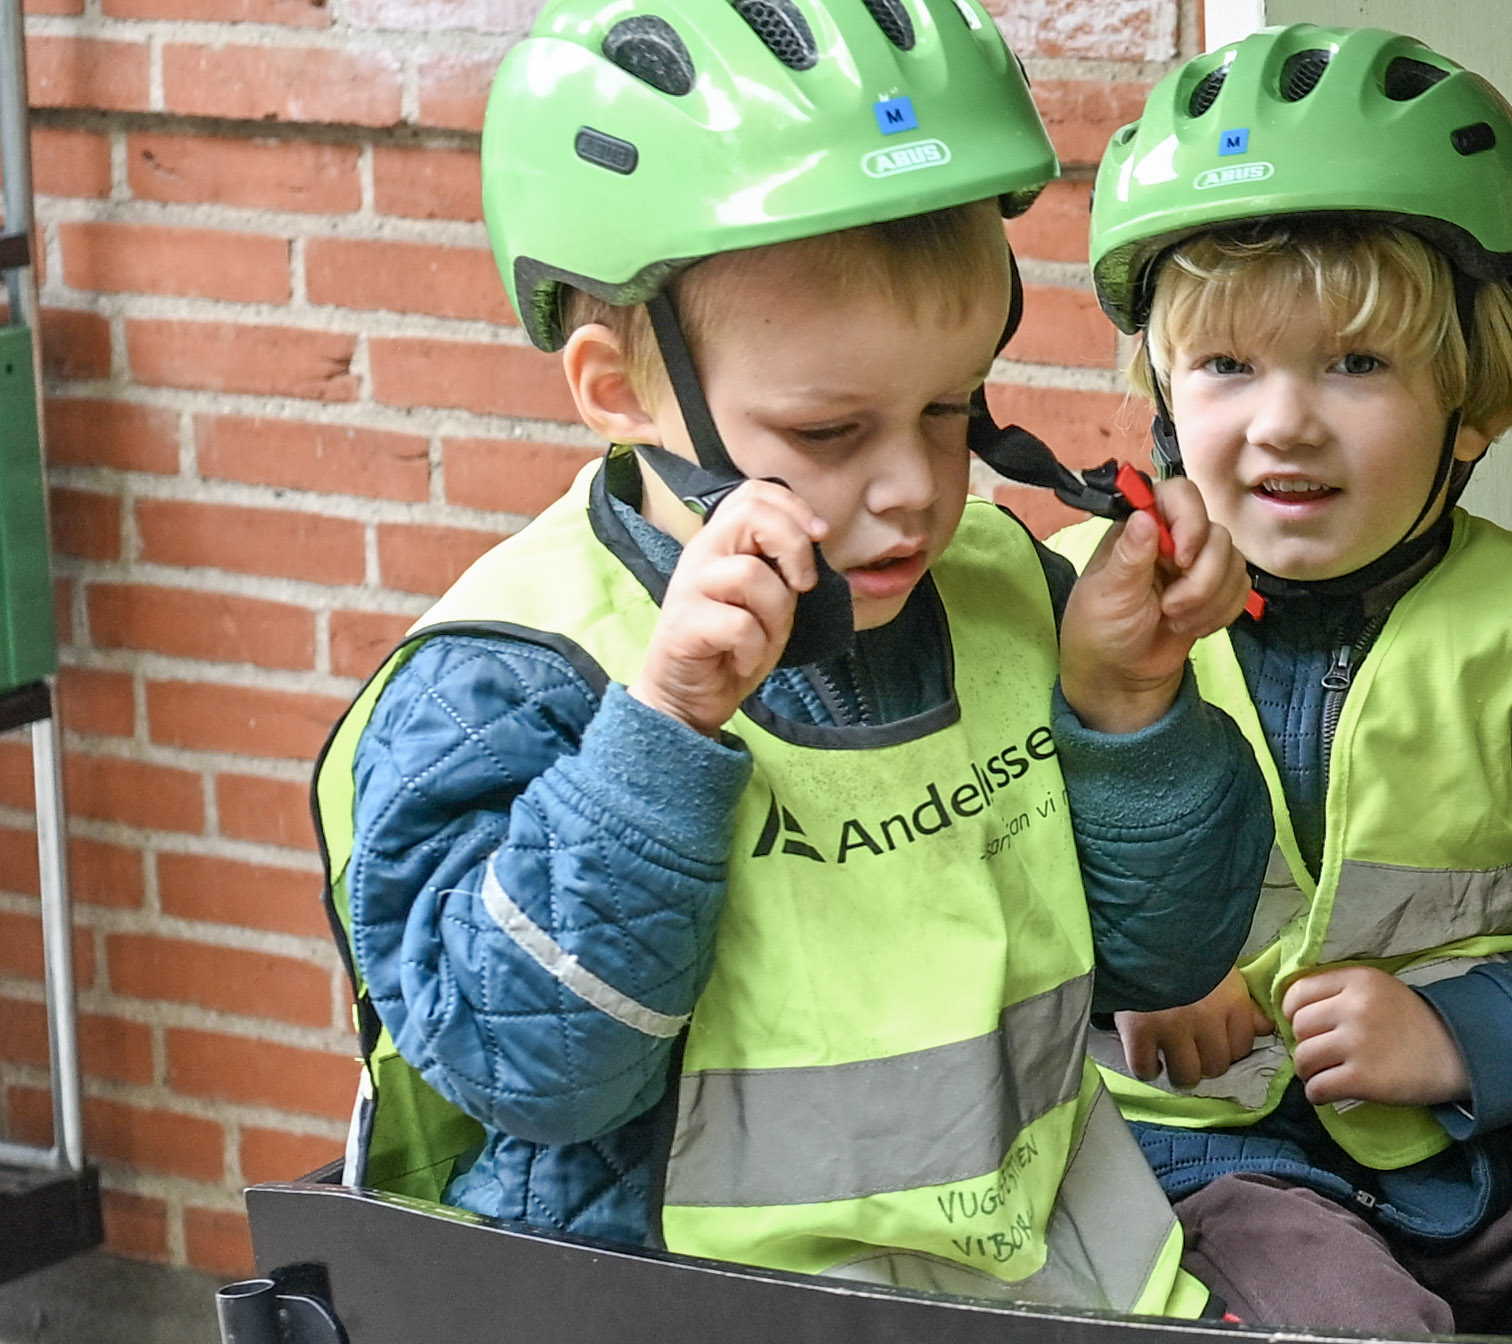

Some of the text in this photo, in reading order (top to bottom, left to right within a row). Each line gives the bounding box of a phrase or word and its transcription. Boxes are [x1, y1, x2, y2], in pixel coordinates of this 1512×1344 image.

[885, 108, 904, 124] M
[875, 143, 944, 173] ABUS
[1201, 165, 1265, 186] ABUS
